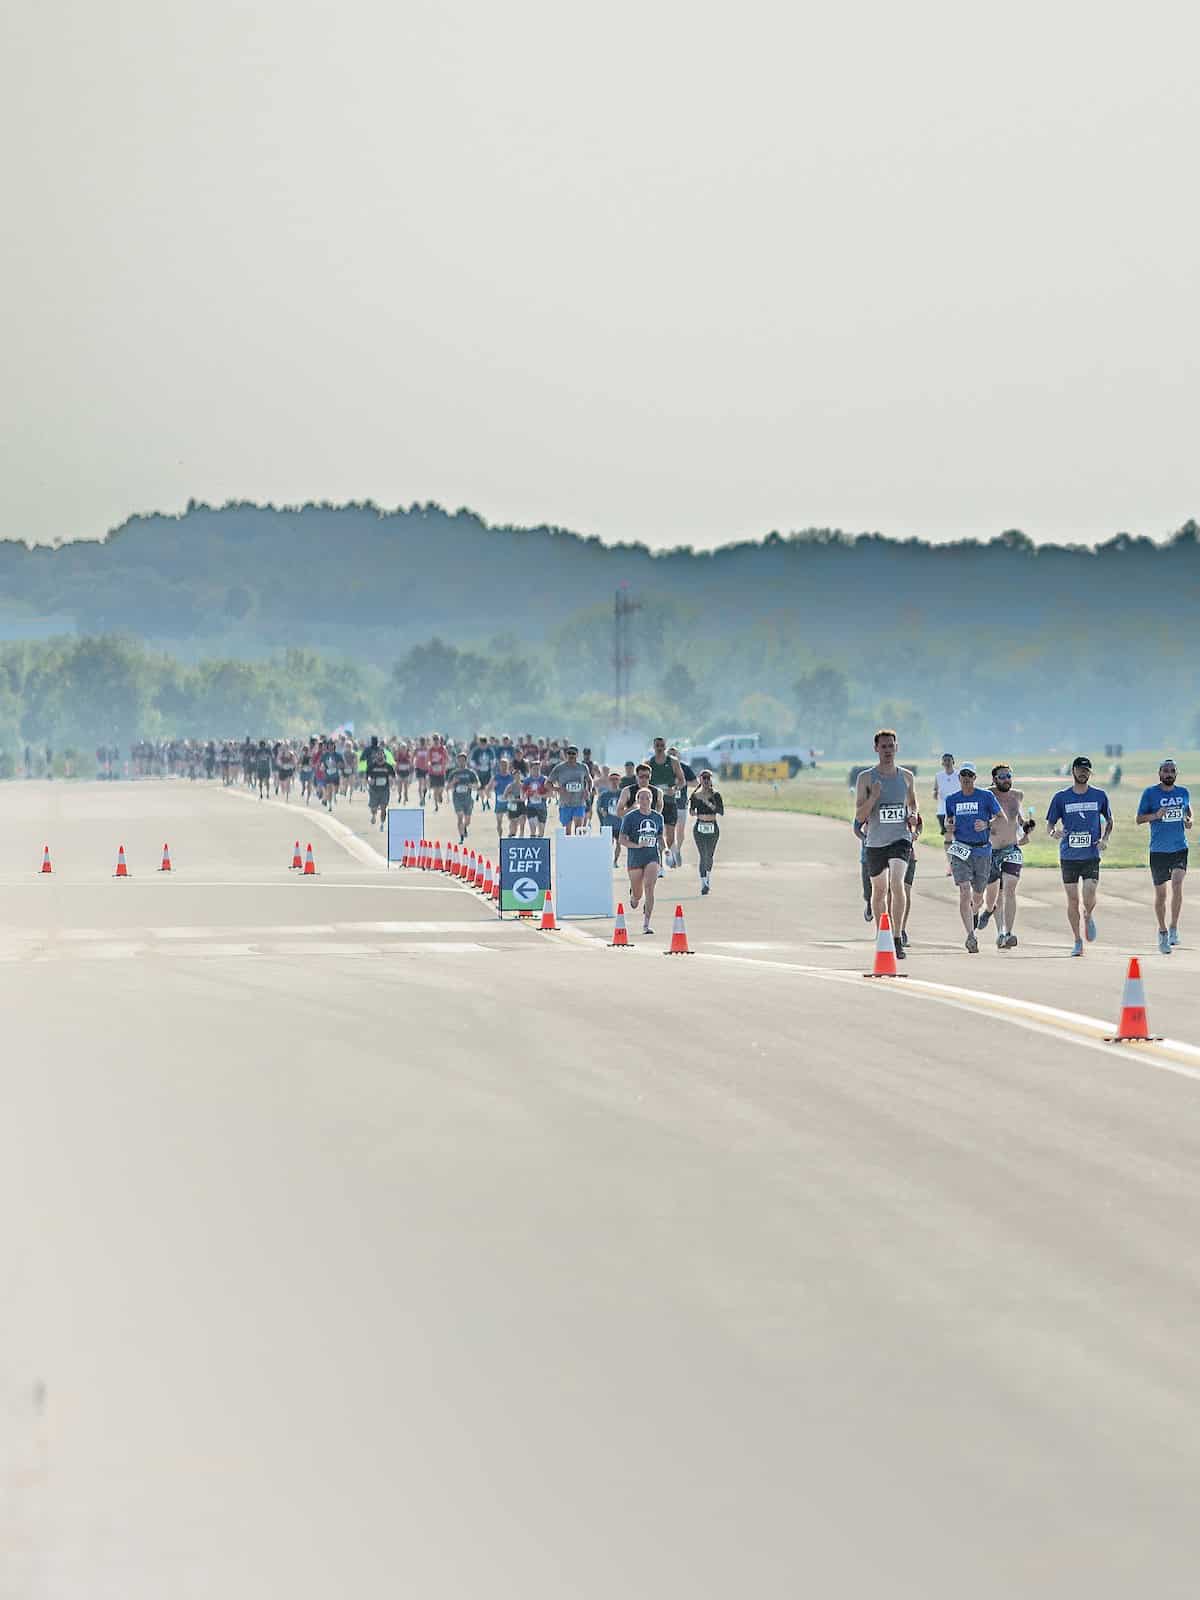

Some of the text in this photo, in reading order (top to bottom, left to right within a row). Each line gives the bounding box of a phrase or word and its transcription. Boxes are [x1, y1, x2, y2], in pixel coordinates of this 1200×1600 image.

[1160, 796, 1184, 806] CAP
[508, 847, 541, 860] STAY
[508, 860, 543, 873] LEFT
